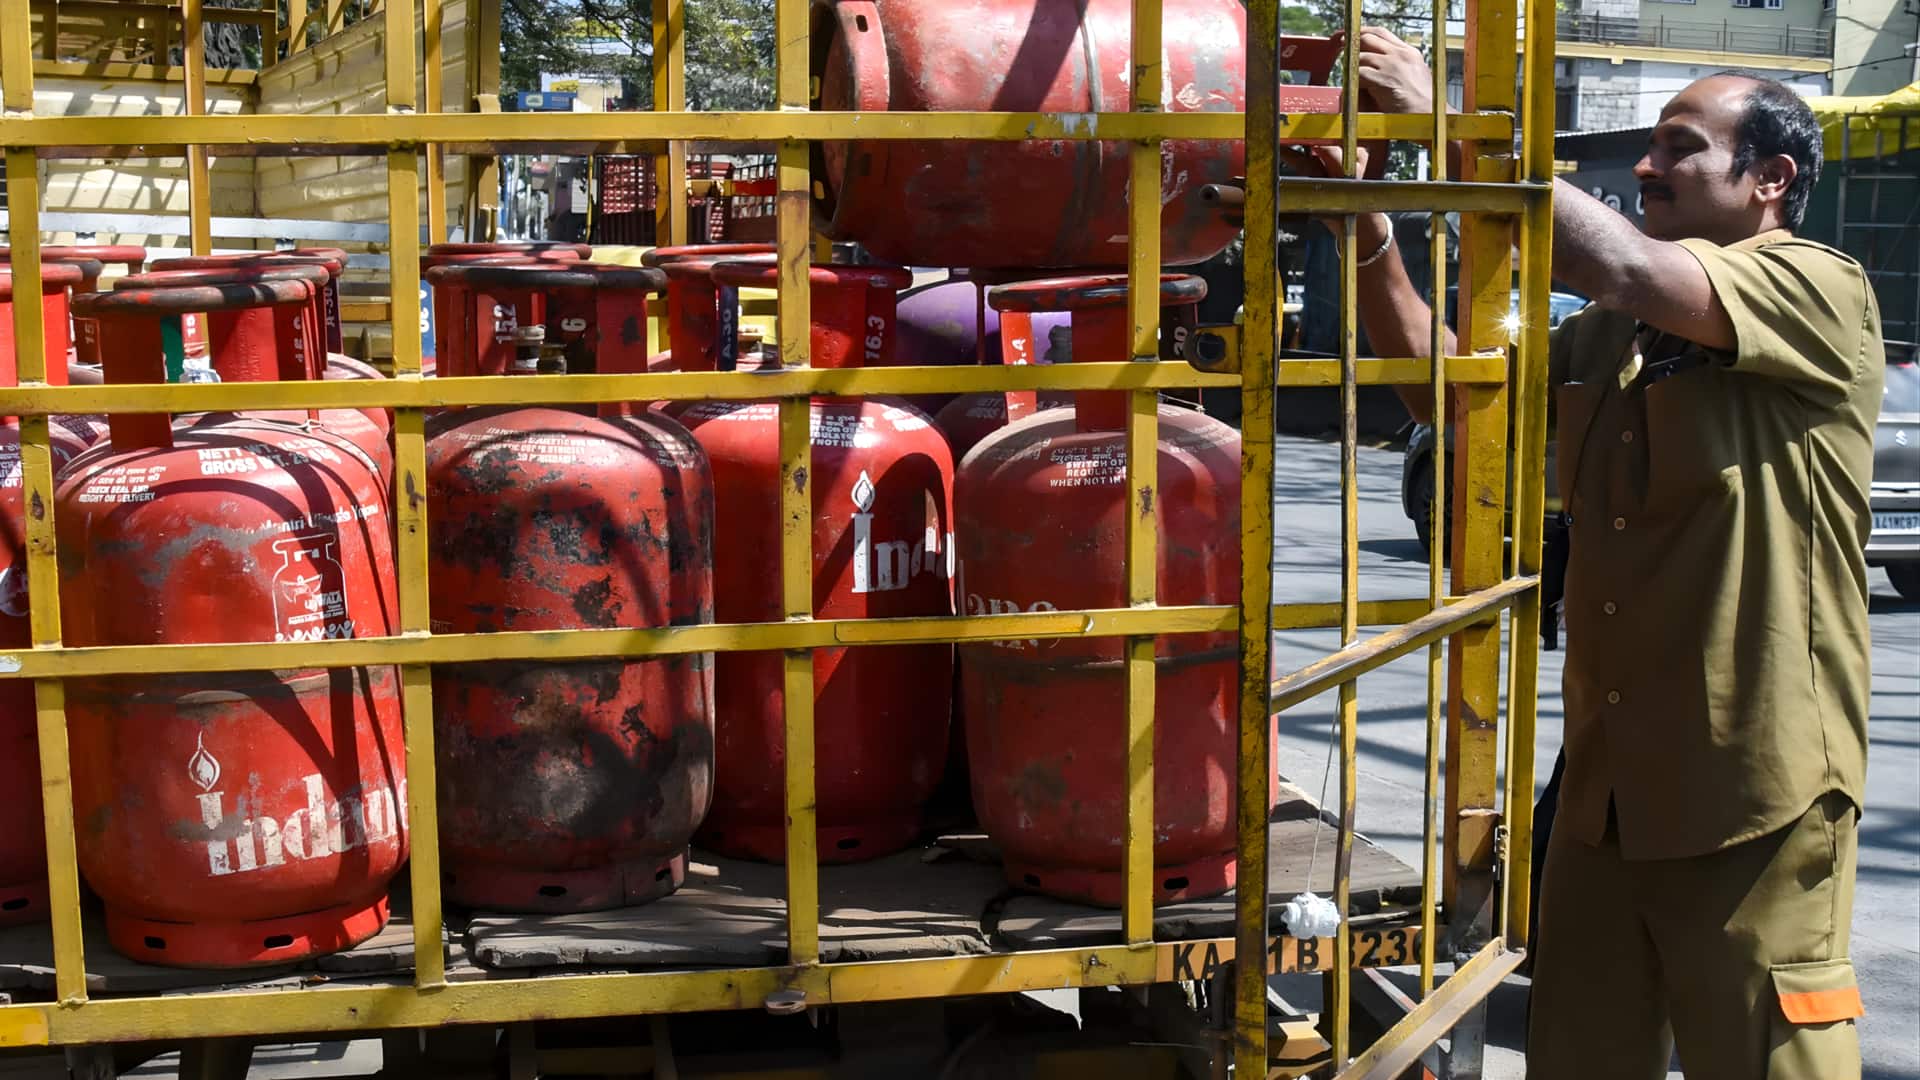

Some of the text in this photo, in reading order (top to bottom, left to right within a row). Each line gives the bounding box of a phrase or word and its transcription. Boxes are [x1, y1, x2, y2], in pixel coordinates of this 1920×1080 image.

[865, 315, 885, 359] 16.3
[198, 447, 241, 460] NETT
[201, 459, 257, 475] GROSS
[1066, 459, 1127, 469] SWITCH OF
[1050, 479, 1081, 488] WHEN
[1084, 476, 1107, 487] NOT
[117, 491, 155, 503] DELIVERY
[1173, 943, 1220, 981] KA
